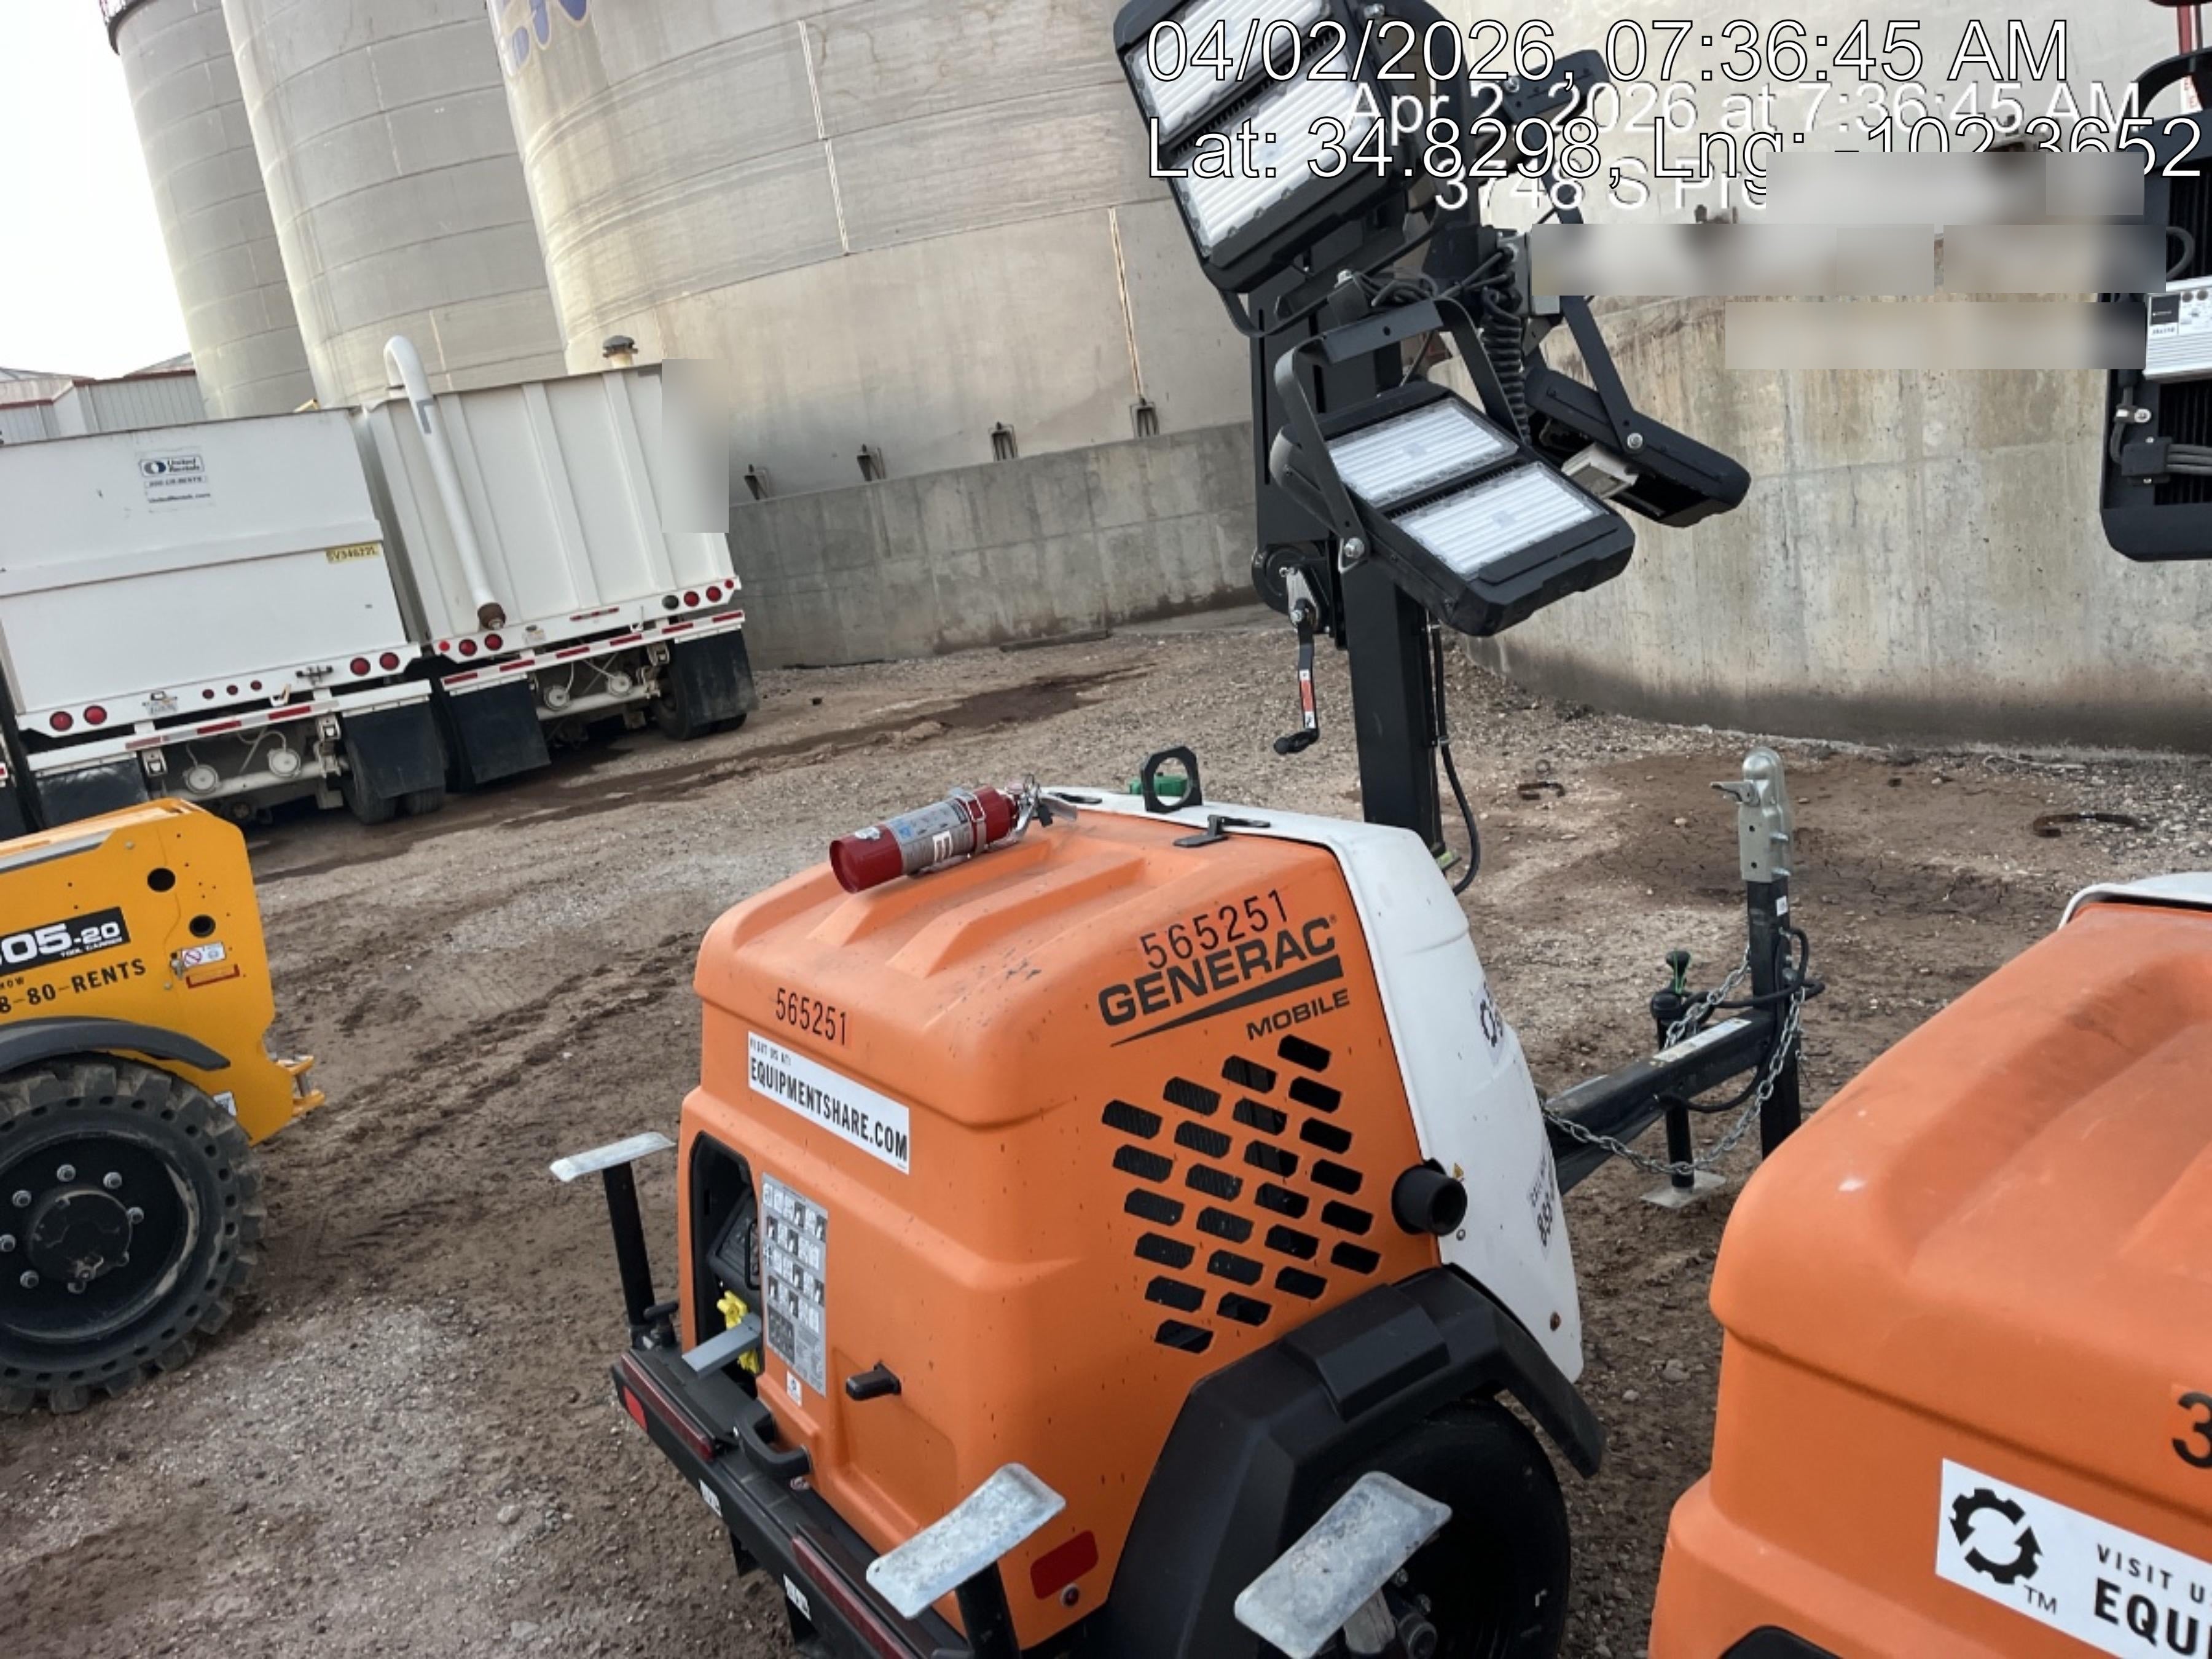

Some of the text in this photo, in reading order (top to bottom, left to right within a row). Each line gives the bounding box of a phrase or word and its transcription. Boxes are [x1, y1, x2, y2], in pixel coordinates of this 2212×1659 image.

[0, 922, 121, 965] 05-20
[1139, 888, 1288, 970] 565251
[1097, 917, 1336, 1027] GENERAC
[775, 987, 848, 1045] 565251
[1245, 988, 1351, 1041] MOBILE
[751, 1056, 908, 1162] EQUIPMENTSHARE.COM
[2171, 1391, 2212, 1469] 3
[2023, 1584, 2057, 1615] TM
[2096, 1543, 2212, 1606] VISIT U
